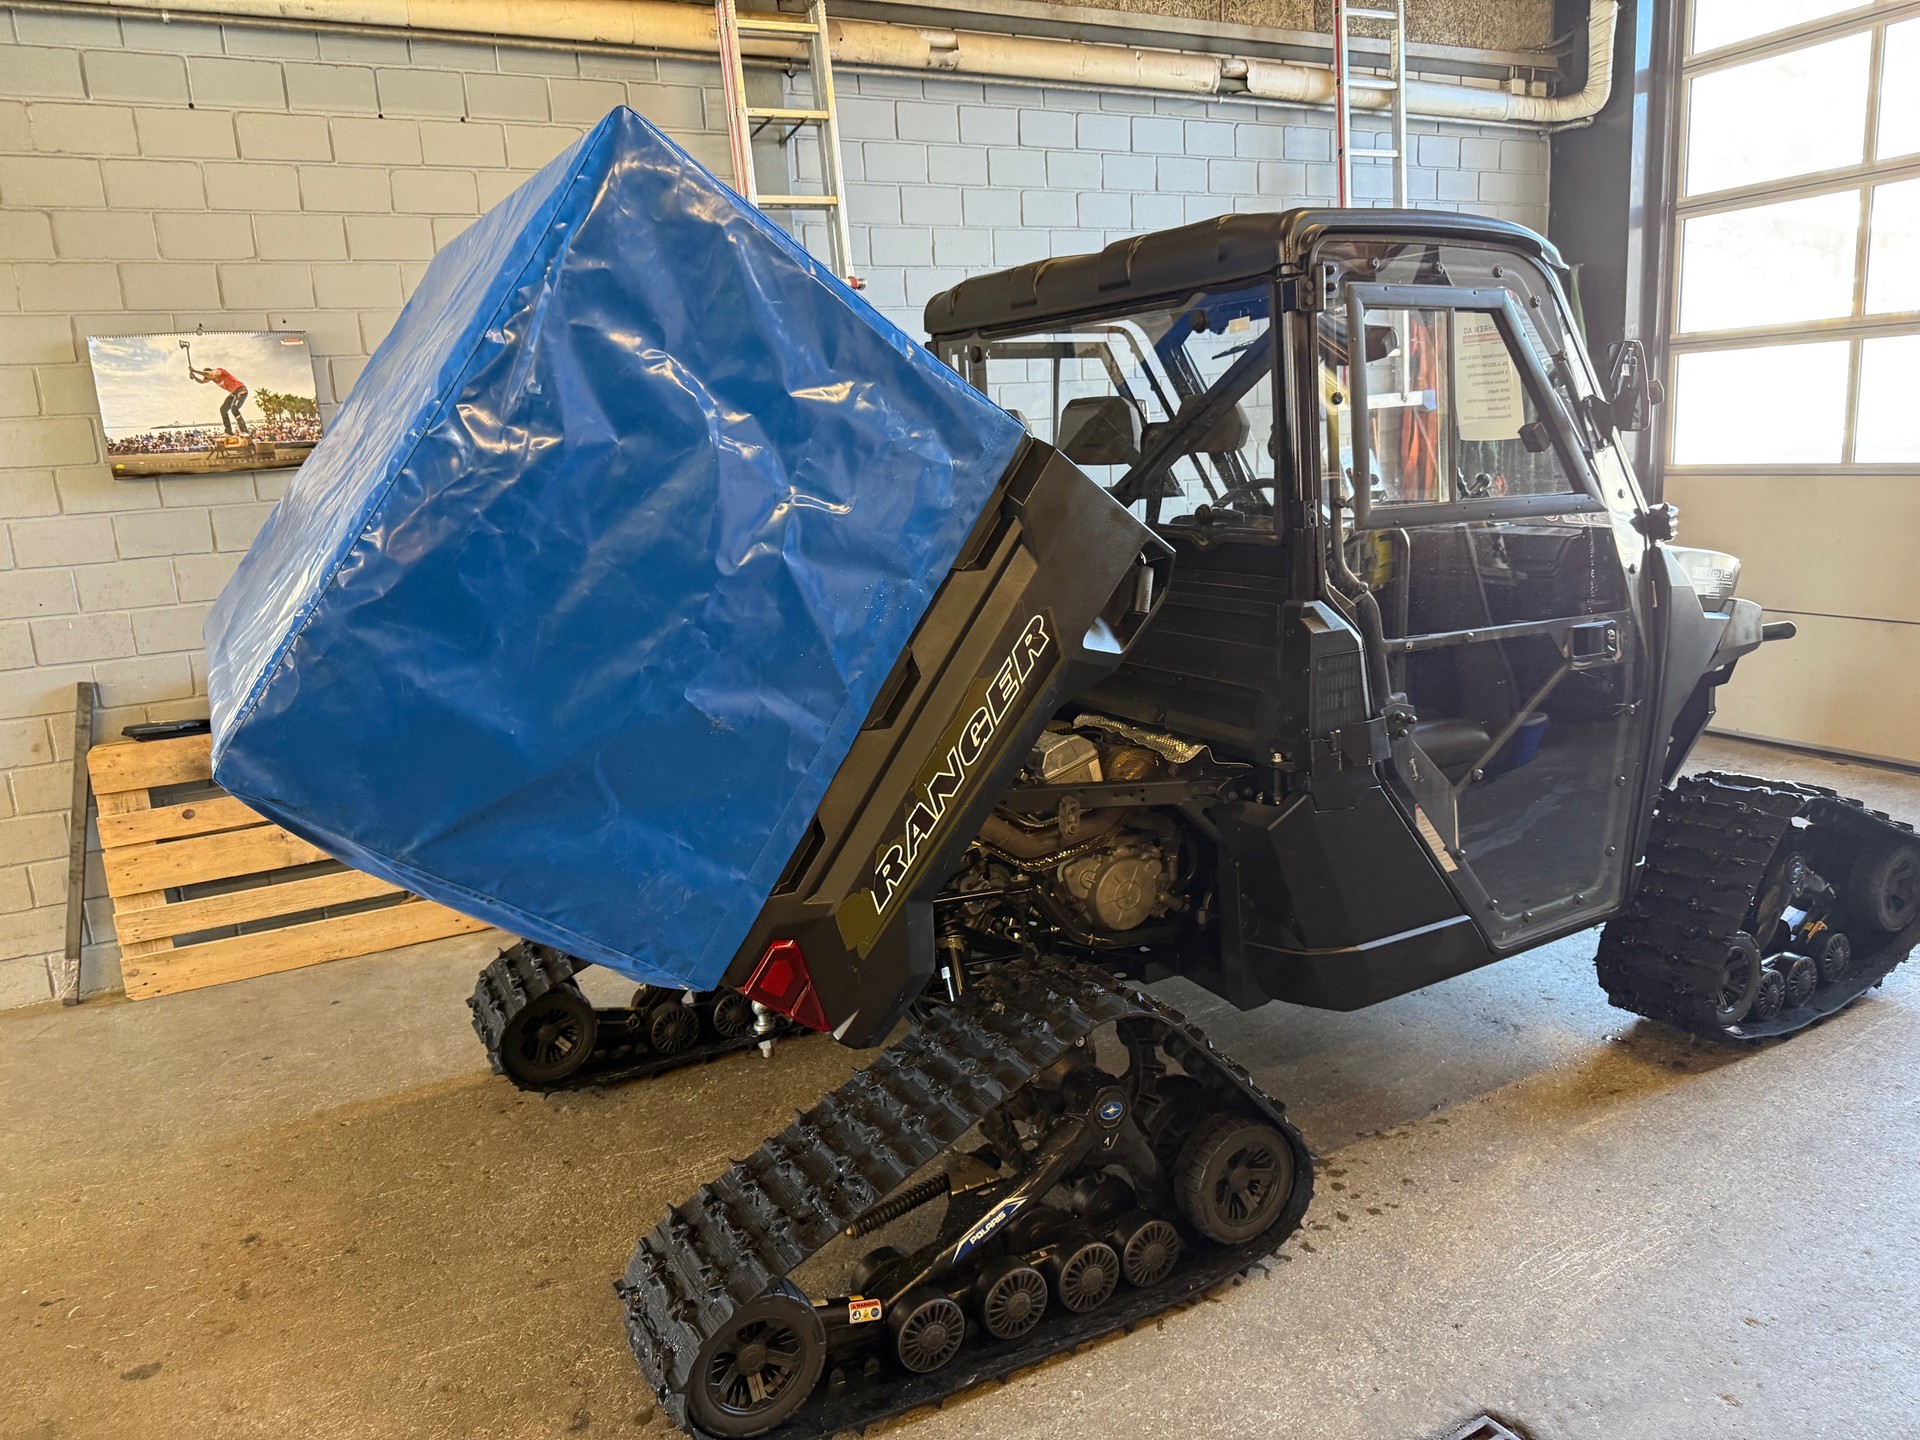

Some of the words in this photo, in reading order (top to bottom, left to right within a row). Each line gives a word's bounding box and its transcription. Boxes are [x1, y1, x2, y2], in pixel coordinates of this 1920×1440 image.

[870, 614, 1050, 915] RANGER
[969, 1211, 1006, 1245] POLARIS
[856, 1300, 879, 1308] WARNING
